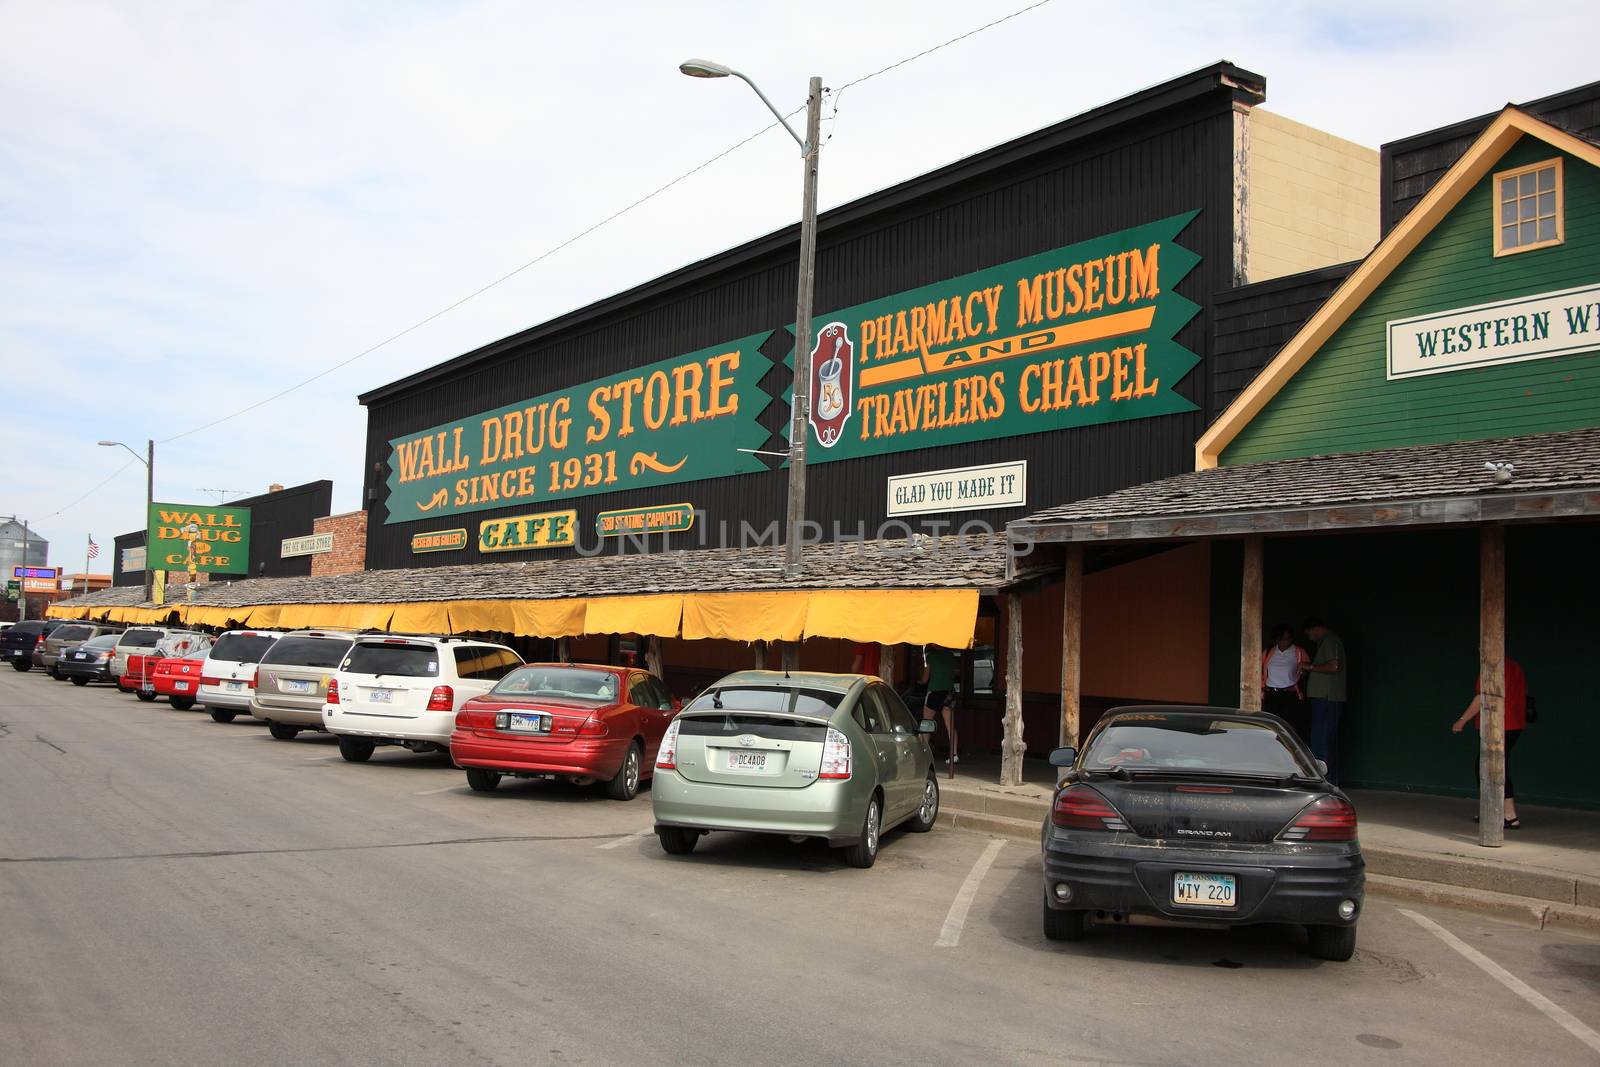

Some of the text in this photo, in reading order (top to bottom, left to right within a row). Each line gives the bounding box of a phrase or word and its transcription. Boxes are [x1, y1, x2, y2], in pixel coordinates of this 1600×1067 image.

[859, 243, 1160, 371] PHARMACY MUSEUM
[943, 332, 1056, 366] AND
[1416, 302, 1600, 359] WESTERN W
[857, 343, 1159, 441] TRAVELERS CHAPEL
[397, 350, 741, 485] WALL DRUG STORE
[454, 450, 618, 508] SINCE 1931
[895, 474, 1015, 506] GLAD YOU MADE IT
[158, 511, 241, 527] WALL
[482, 515, 570, 547] CAFE
[1178, 883, 1232, 901] WIY 220
